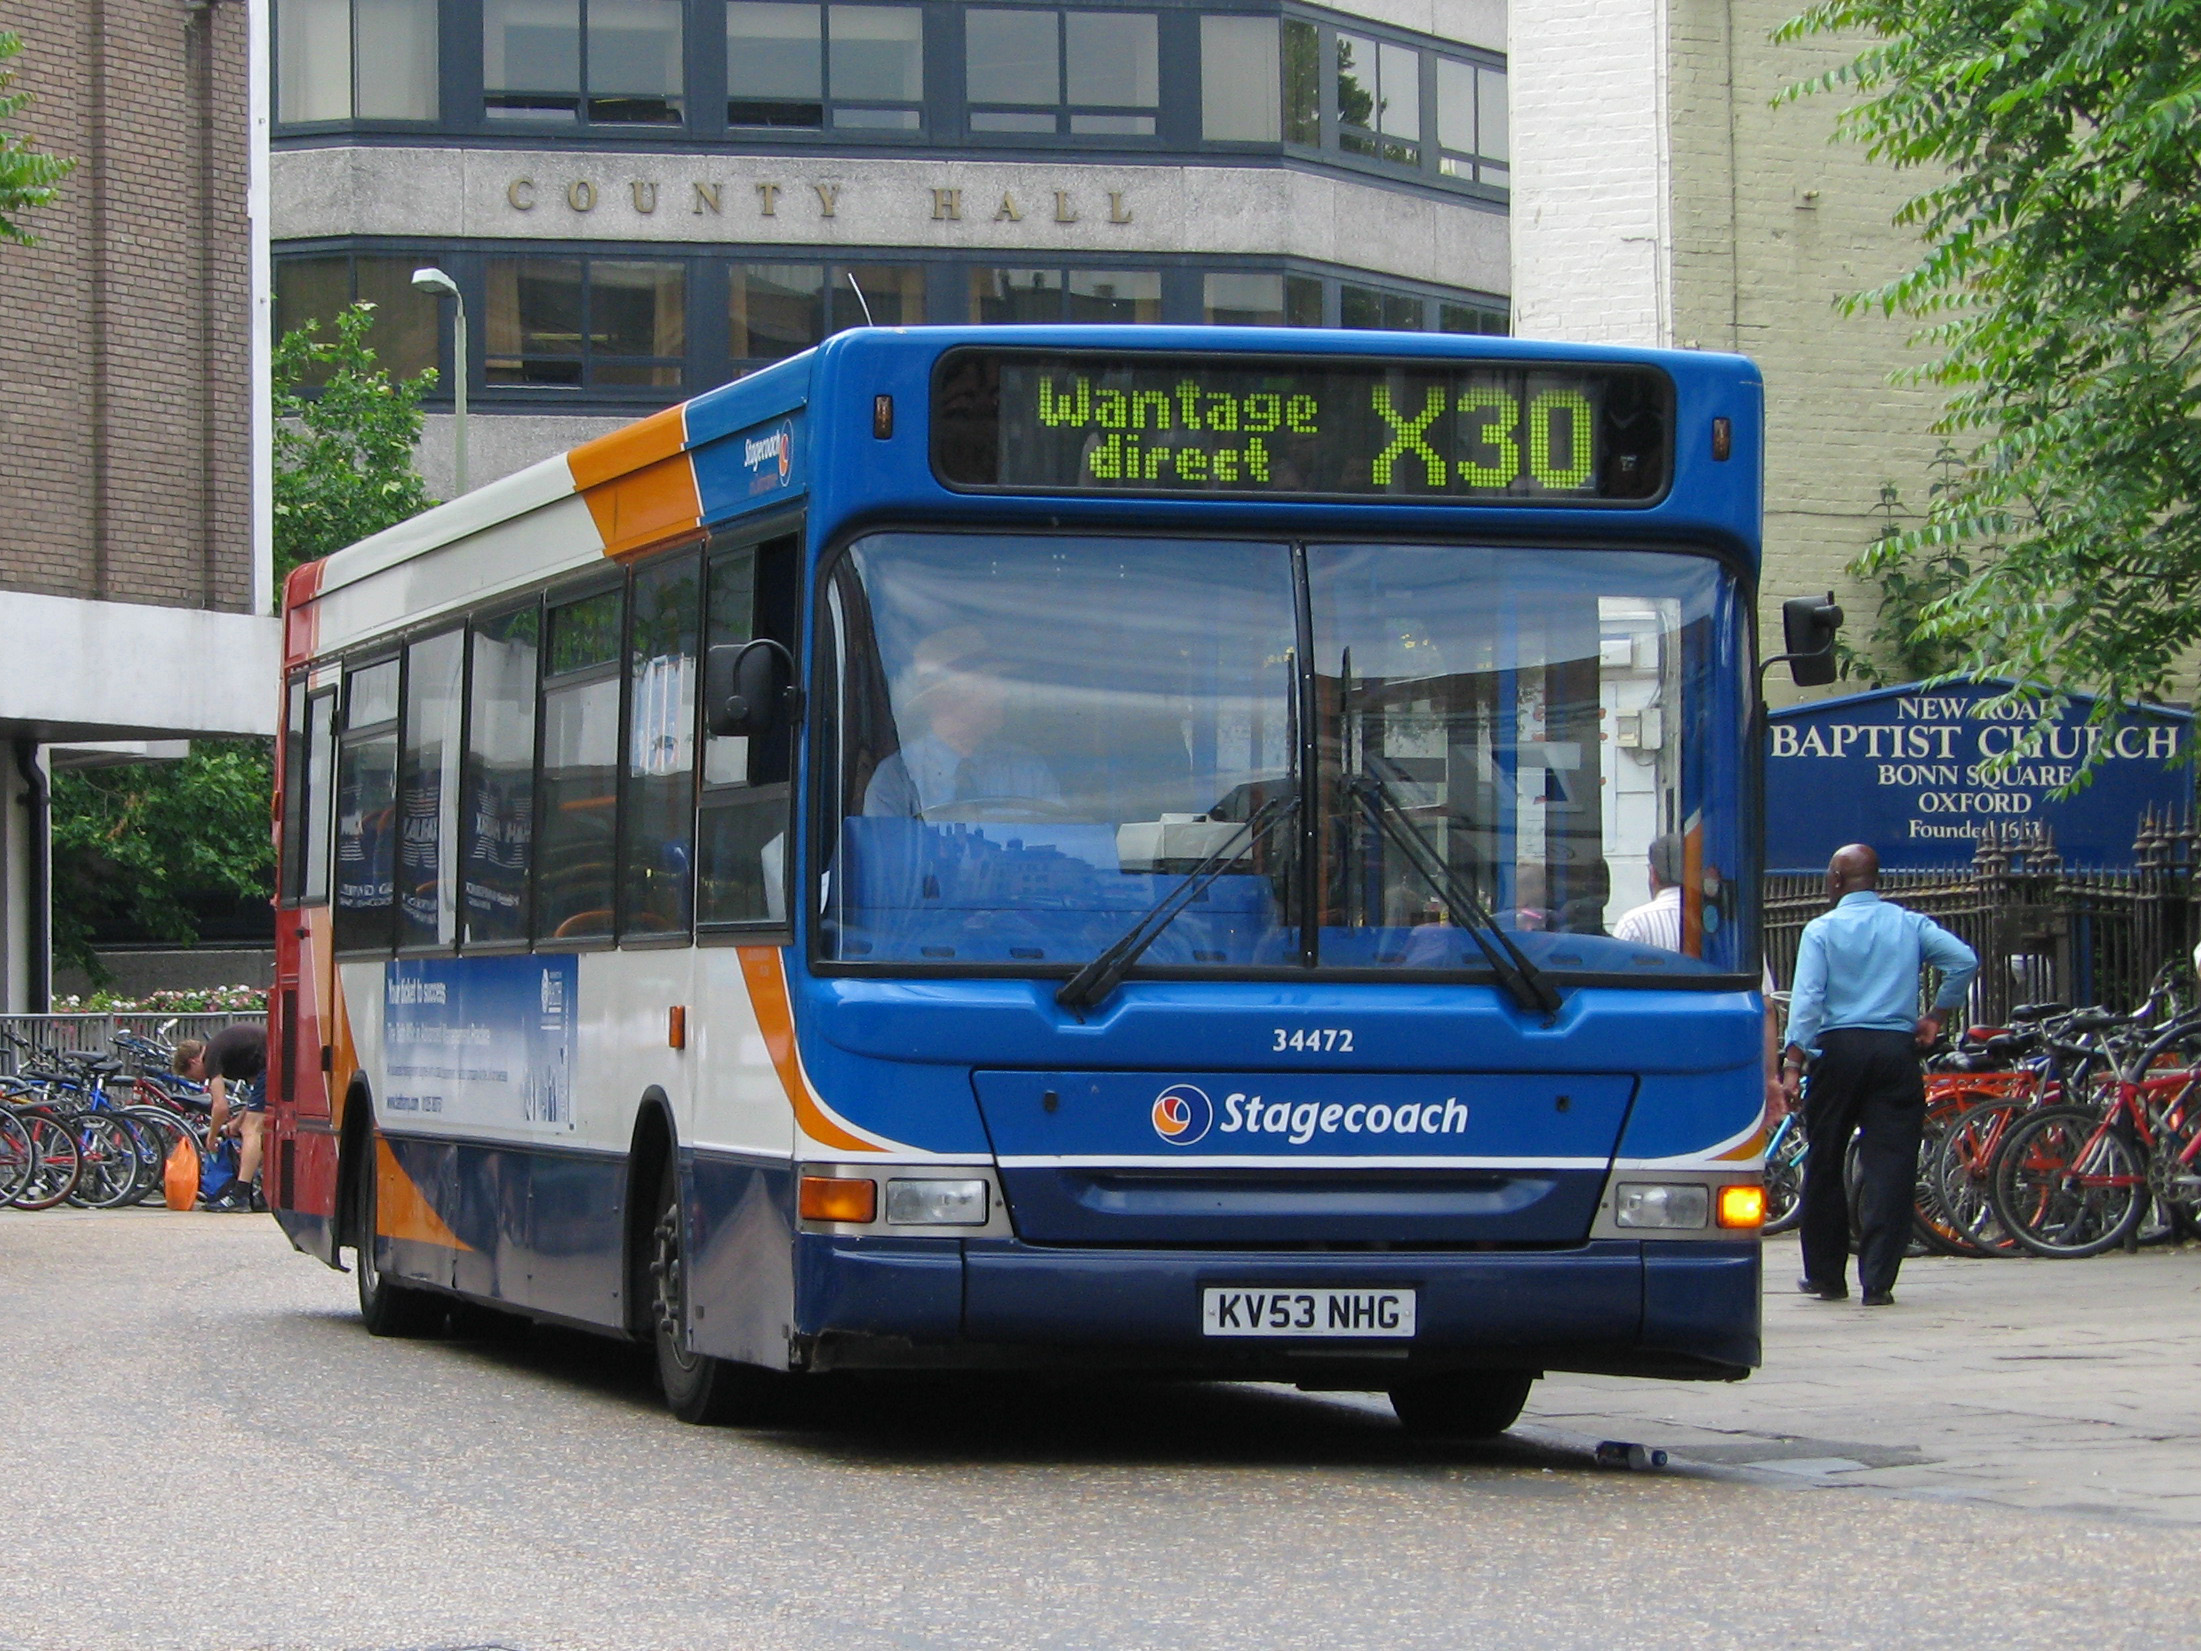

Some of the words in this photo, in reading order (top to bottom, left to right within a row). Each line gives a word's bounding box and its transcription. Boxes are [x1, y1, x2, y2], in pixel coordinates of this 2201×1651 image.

[508, 177, 842, 217] COUNTY
[931, 187, 1133, 223] HALL
[1039, 376, 1318, 433] Wantage
[1371, 384, 1593, 489] X30
[1089, 433, 1269, 482] direct
[1897, 697, 1968, 720] NEW
[1771, 725, 1962, 759] BAPTIST
[1977, 725, 2179, 760] CHURCH
[1878, 764, 1959, 786] BONN
[1966, 765, 2073, 790] SQUARE
[1918, 792, 2033, 813] OXFORD
[1908, 819, 1996, 839] Founded
[1272, 1028, 1354, 1053] 34472
[1219, 1092, 1469, 1144] Stagecoach
[1219, 1294, 1316, 1329] KV53
[1328, 1295, 1400, 1329] NHG
